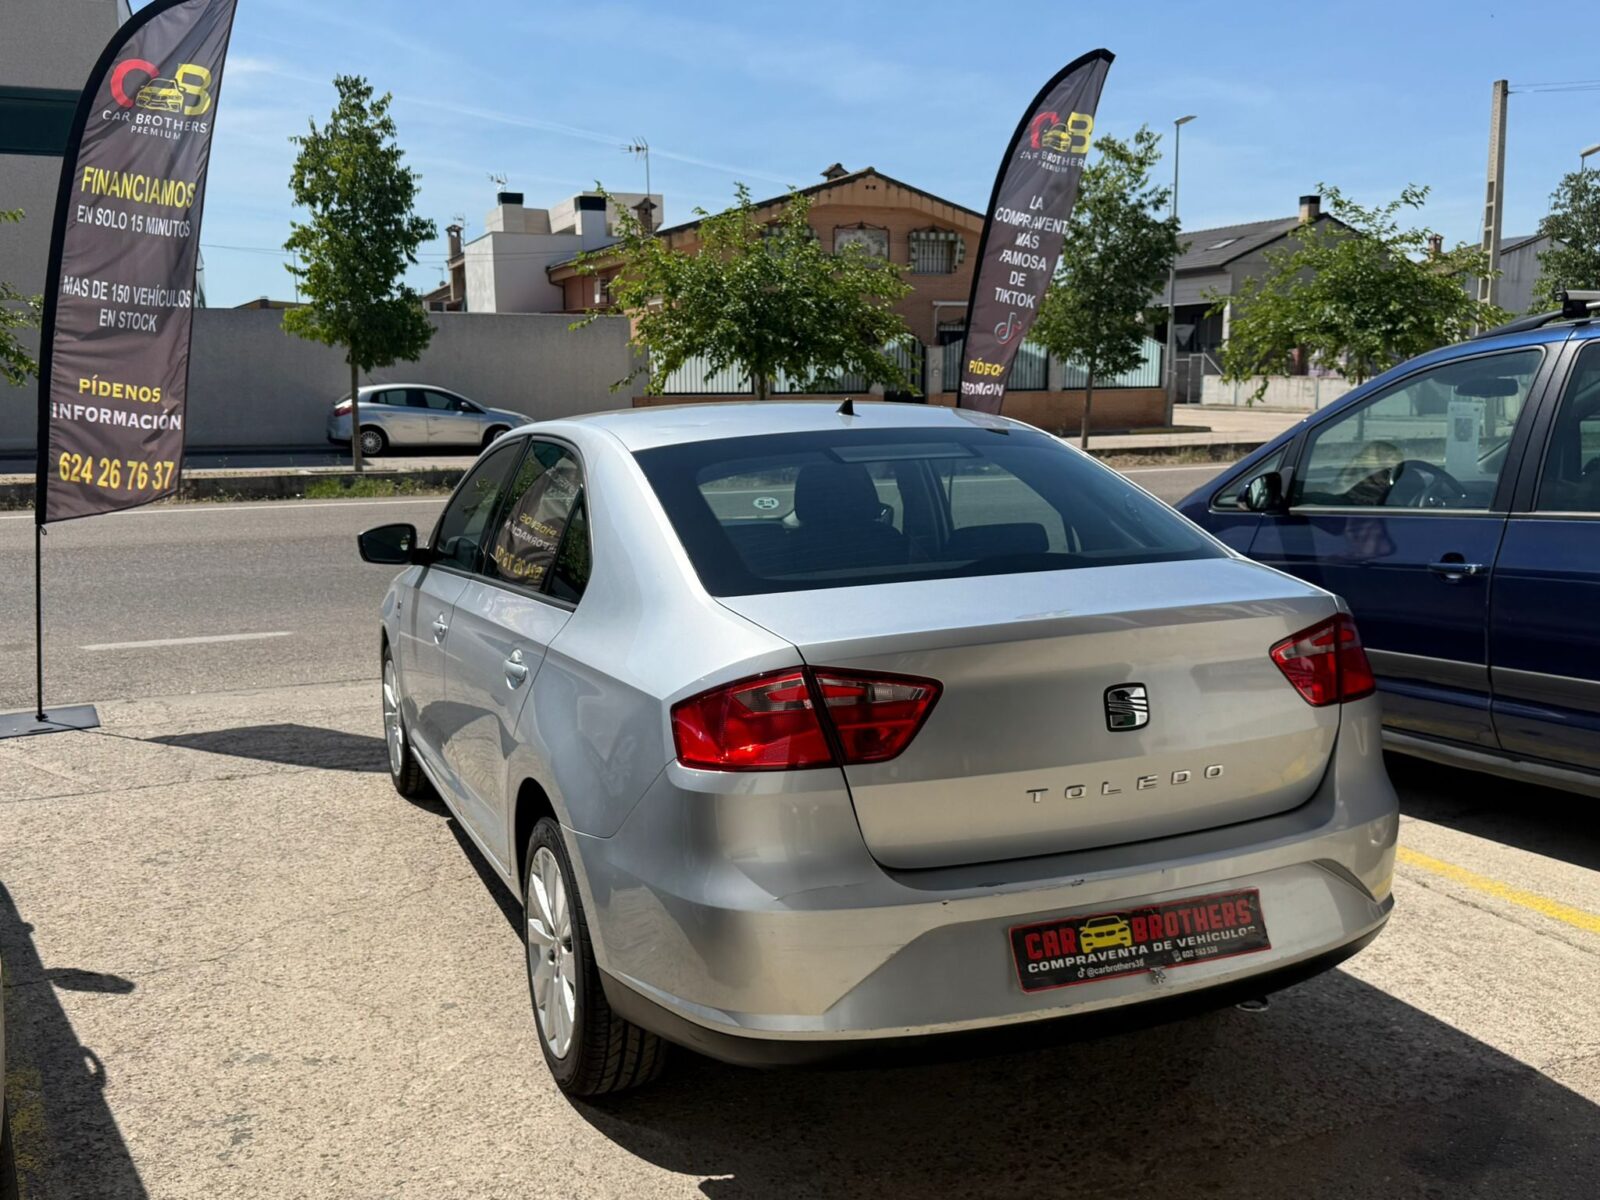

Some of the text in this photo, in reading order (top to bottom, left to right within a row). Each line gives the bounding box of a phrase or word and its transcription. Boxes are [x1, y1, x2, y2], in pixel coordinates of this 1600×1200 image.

[102, 110, 208, 133] CAR BROTHERS
[131, 125, 181, 140] PREMIUM
[1041, 152, 1085, 168] BROTHER
[81, 166, 195, 208] FINANCIAMOS
[1030, 195, 1043, 210] LA
[77, 205, 190, 238] EN SOLO 15 MINUTOS
[994, 207, 1069, 235] COMPRAVENT
[999, 249, 1046, 271] FAMOSA
[63, 275, 191, 308] MAS DE 150 VEHÍCULOS
[1009, 271, 1026, 287] DE
[995, 287, 1036, 309] TIKTOK
[99, 308, 158, 332] EN STOCK
[79, 374, 161, 403] PÍDENOS
[52, 402, 182, 430] INFORMACIÓN
[59, 452, 175, 491] 624 26 76 37
[1026, 764, 1224, 803] TOLEDO
[1024, 899, 1253, 960] CAR BROTHERS
[1028, 945, 1149, 973] COMPRAVENTA
[1153, 940, 1172, 952] DE
